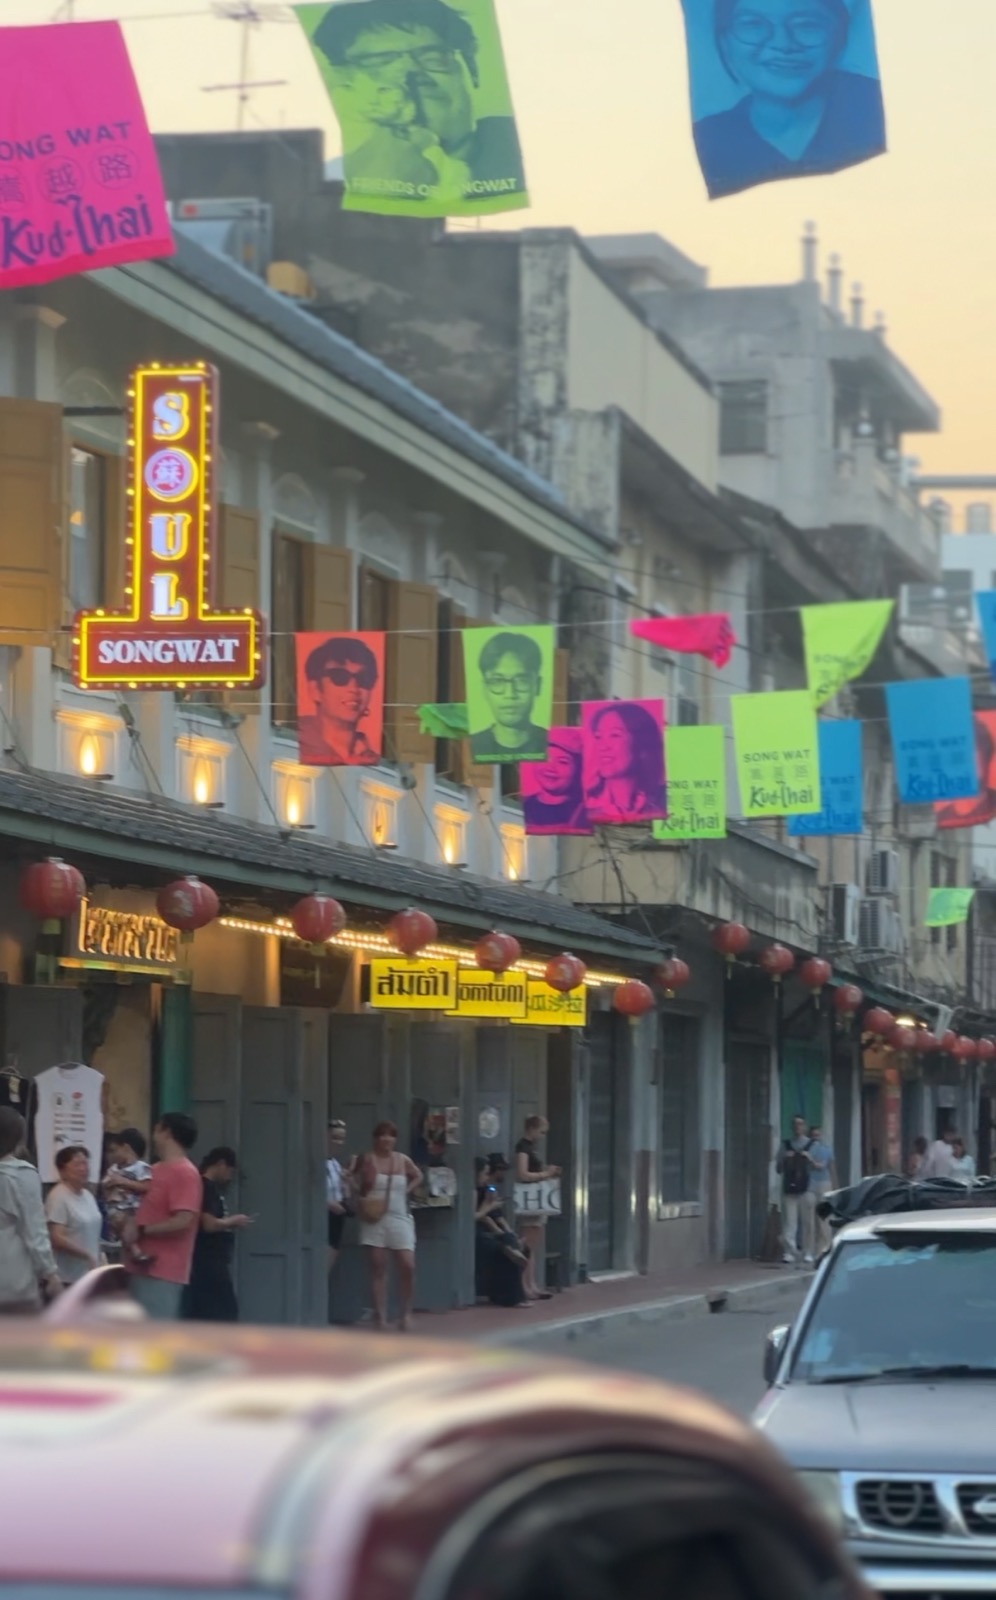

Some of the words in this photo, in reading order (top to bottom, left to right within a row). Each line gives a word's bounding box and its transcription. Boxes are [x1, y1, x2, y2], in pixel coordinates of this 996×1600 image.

[0, 134, 55, 161] ONG
[66, 121, 131, 147] WAT
[352, 177, 415, 195] FRIENDS
[461, 177, 517, 194] NGWAT
[98, 638, 240, 664] SONGWAT
[743, 751, 779, 763] SONG
[783, 749, 810, 761] WAT
[693, 780, 719, 789] WAT
[377, 966, 449, 996] ส้มตำ
[459, 984, 523, 1003] omtum
